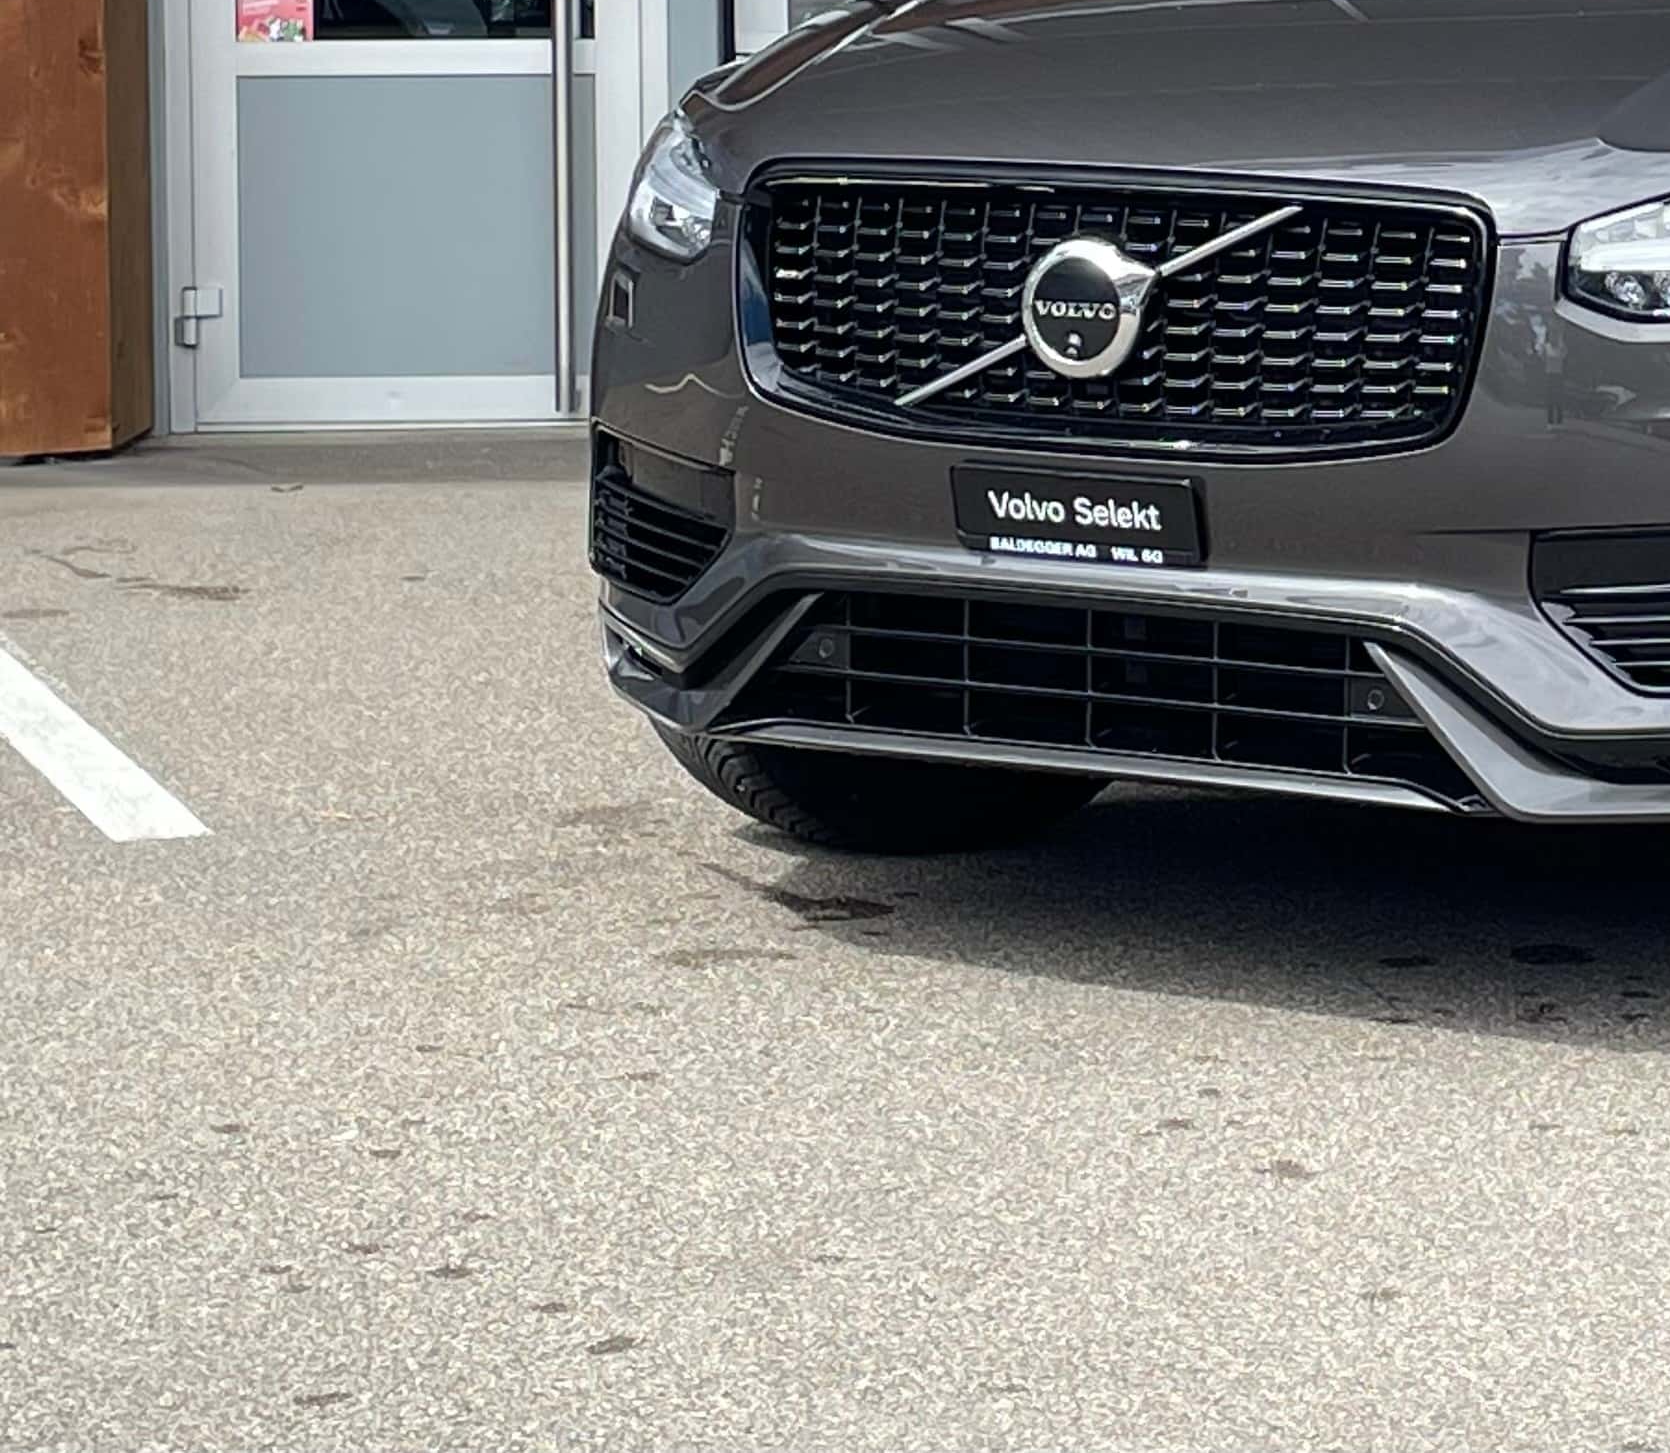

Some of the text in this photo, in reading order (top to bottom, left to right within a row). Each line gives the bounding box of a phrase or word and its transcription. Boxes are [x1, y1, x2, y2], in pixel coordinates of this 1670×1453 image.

[1034, 299, 1117, 320] VOLVO
[987, 490, 1162, 531] Volvo Selekt
[989, 536, 1073, 557] BALDEGGER
[1075, 543, 1098, 558] AG
